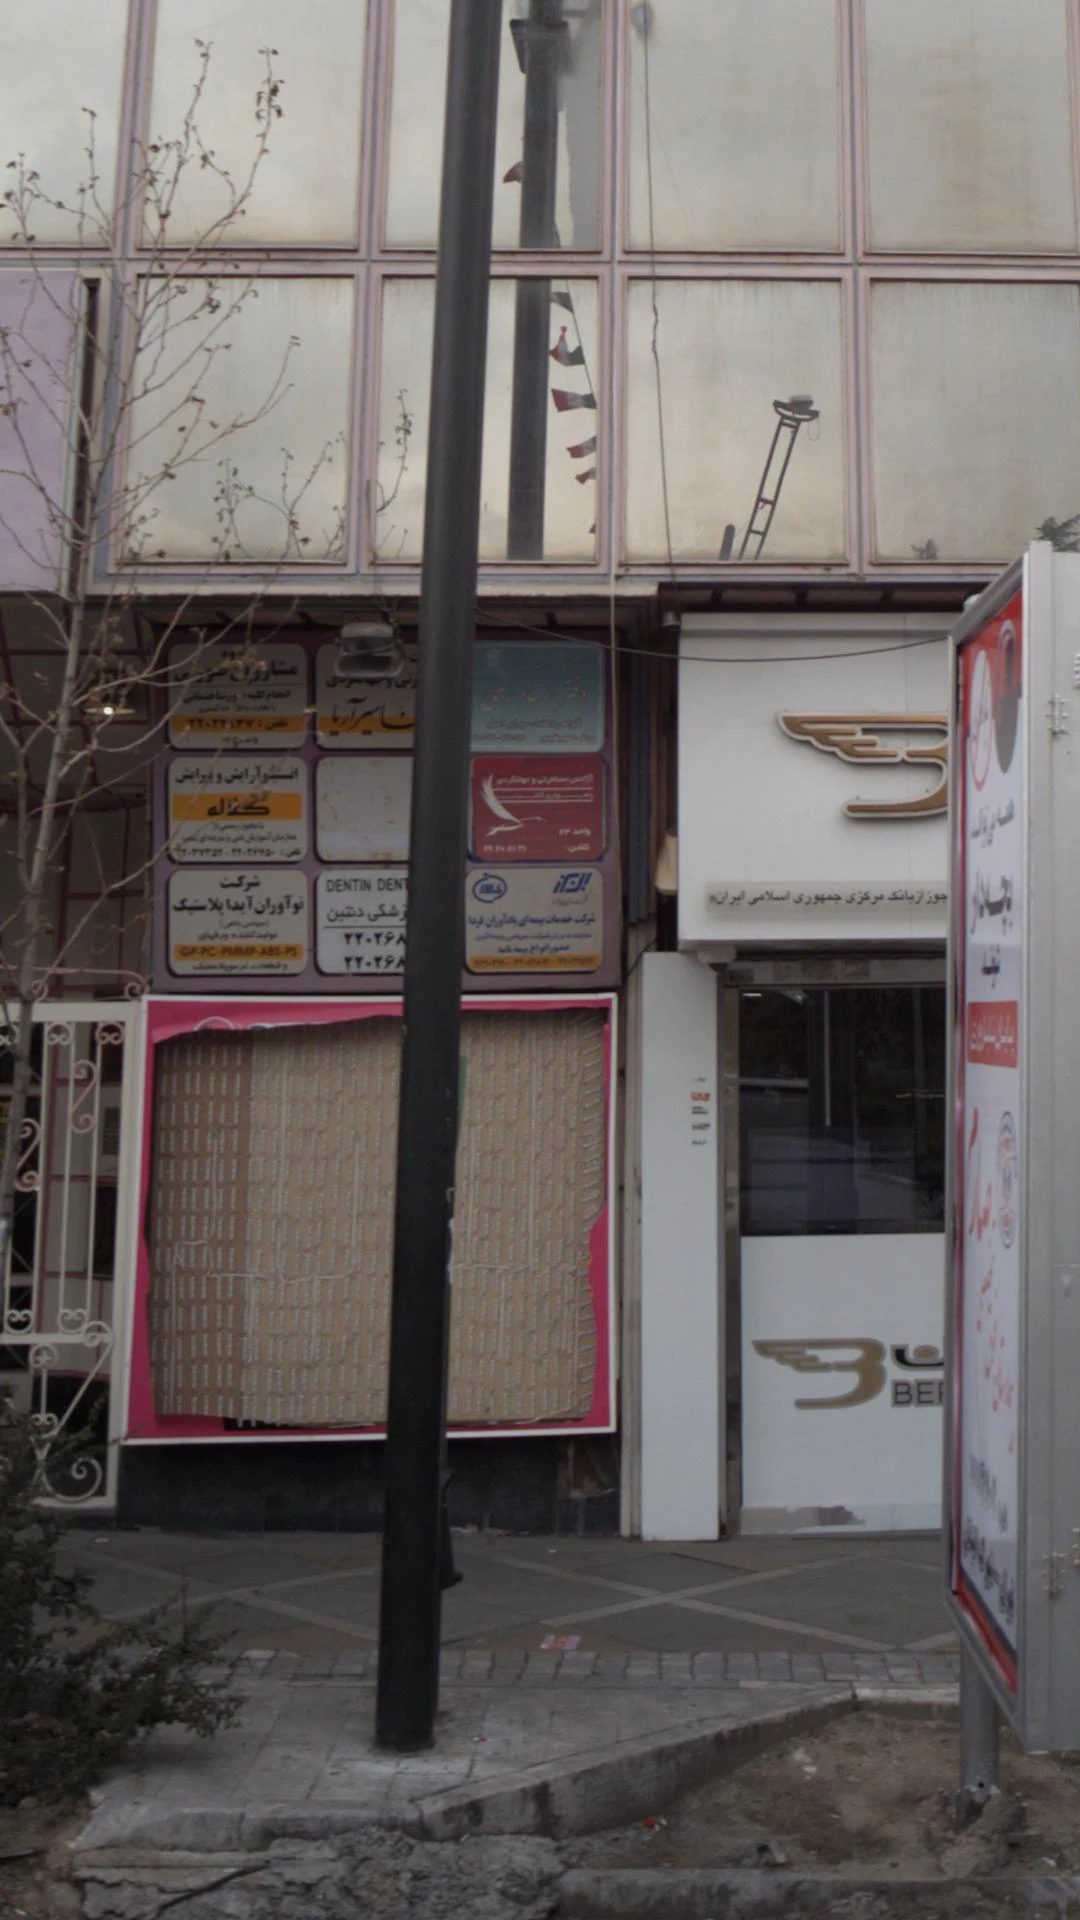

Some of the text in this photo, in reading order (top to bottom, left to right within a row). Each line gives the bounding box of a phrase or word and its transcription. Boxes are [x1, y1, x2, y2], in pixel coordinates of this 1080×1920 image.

[219, 874, 262, 893] شرکت
[326, 878, 372, 894] DENTIN
[748, 889, 791, 907] اسلامی
[792, 891, 843, 907] جمهوری
[845, 889, 885, 909] مرکزی
